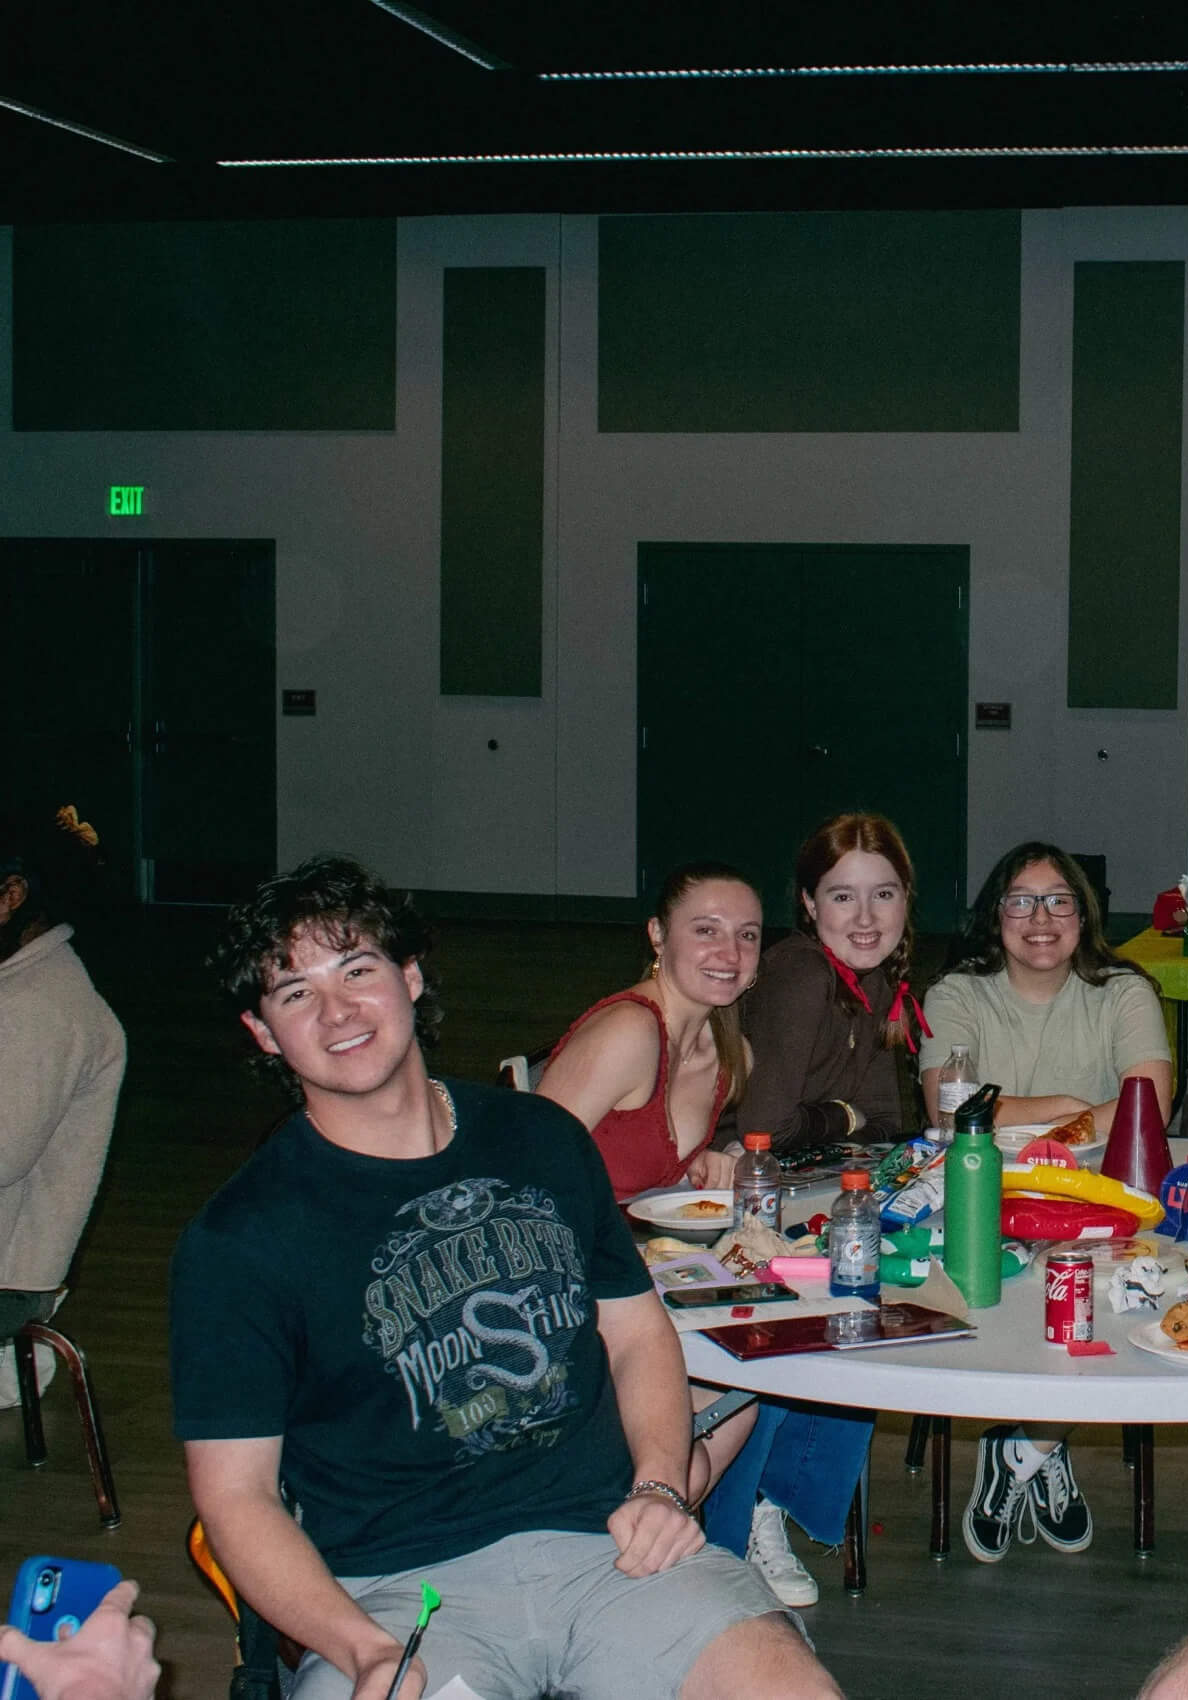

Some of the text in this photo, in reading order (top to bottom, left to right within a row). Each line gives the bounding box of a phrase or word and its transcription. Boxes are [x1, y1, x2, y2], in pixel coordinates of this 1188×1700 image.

[110, 486, 144, 515] EXIT
[366, 1217, 585, 1358] SNAKE BITE
[396, 1327, 482, 1430] MOON
